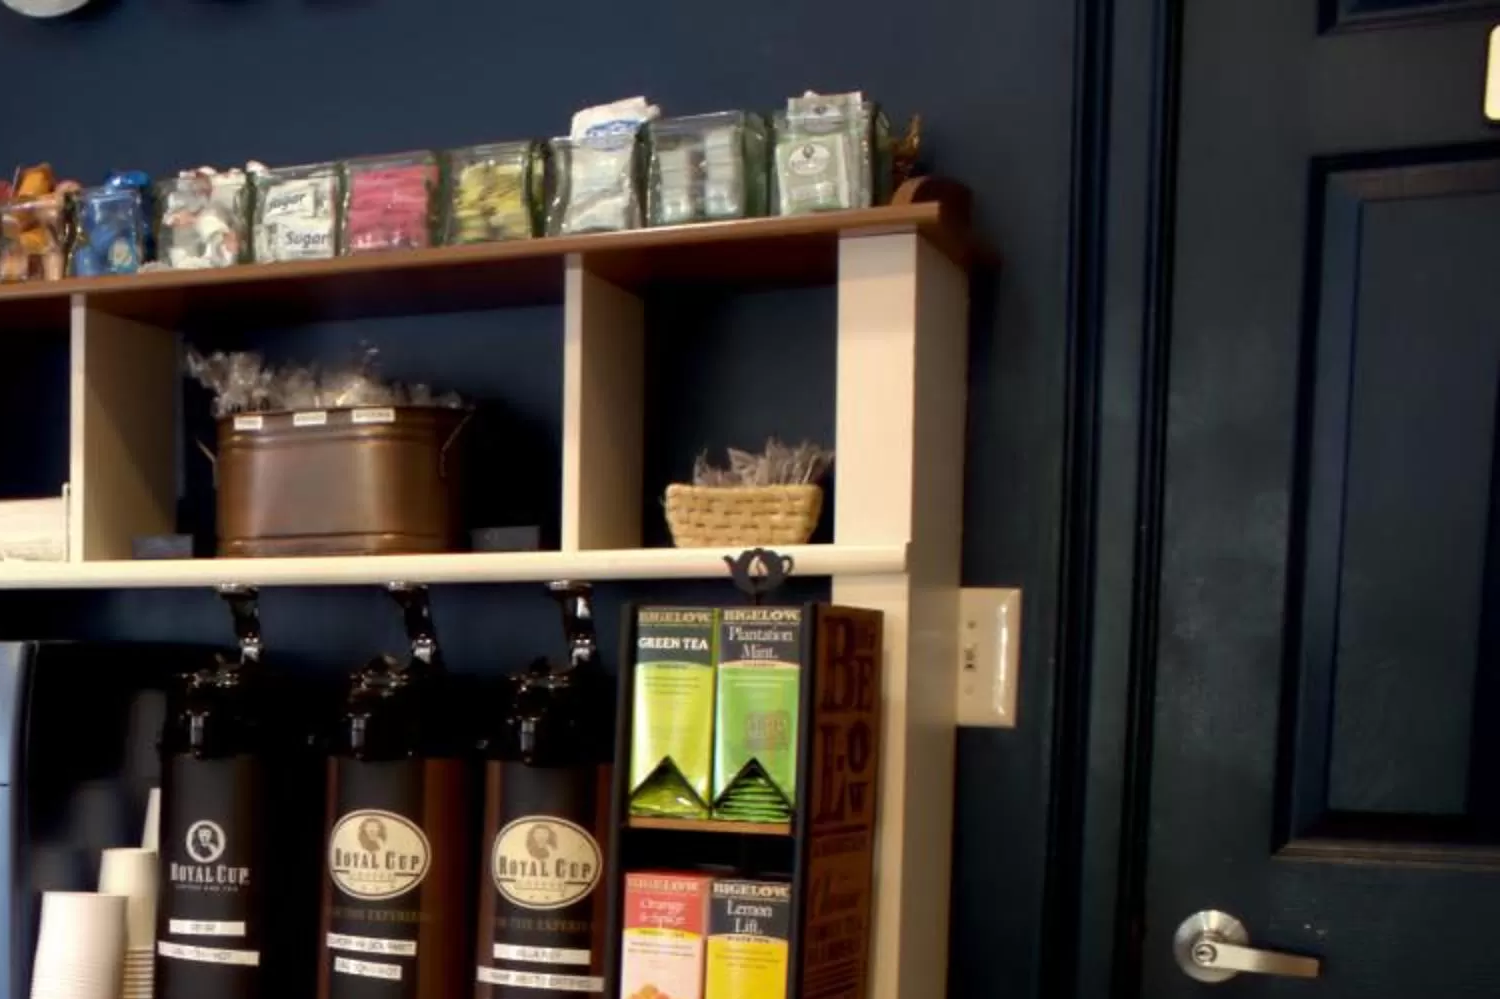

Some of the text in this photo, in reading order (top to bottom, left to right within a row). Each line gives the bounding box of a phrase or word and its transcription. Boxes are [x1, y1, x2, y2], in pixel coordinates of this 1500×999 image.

[285, 230, 326, 249] Sugar
[723, 608, 801, 622] BIGELOW
[637, 636, 709, 650] GREEN TEA
[728, 625, 794, 642] Plantation
[335, 847, 420, 871] ROYAL CUP
[499, 855, 592, 879] ROYAL CUP
[169, 862, 250, 886] ROYAL CUP
[712, 881, 791, 898] BIGELOW
[726, 898, 773, 918] Lemon
